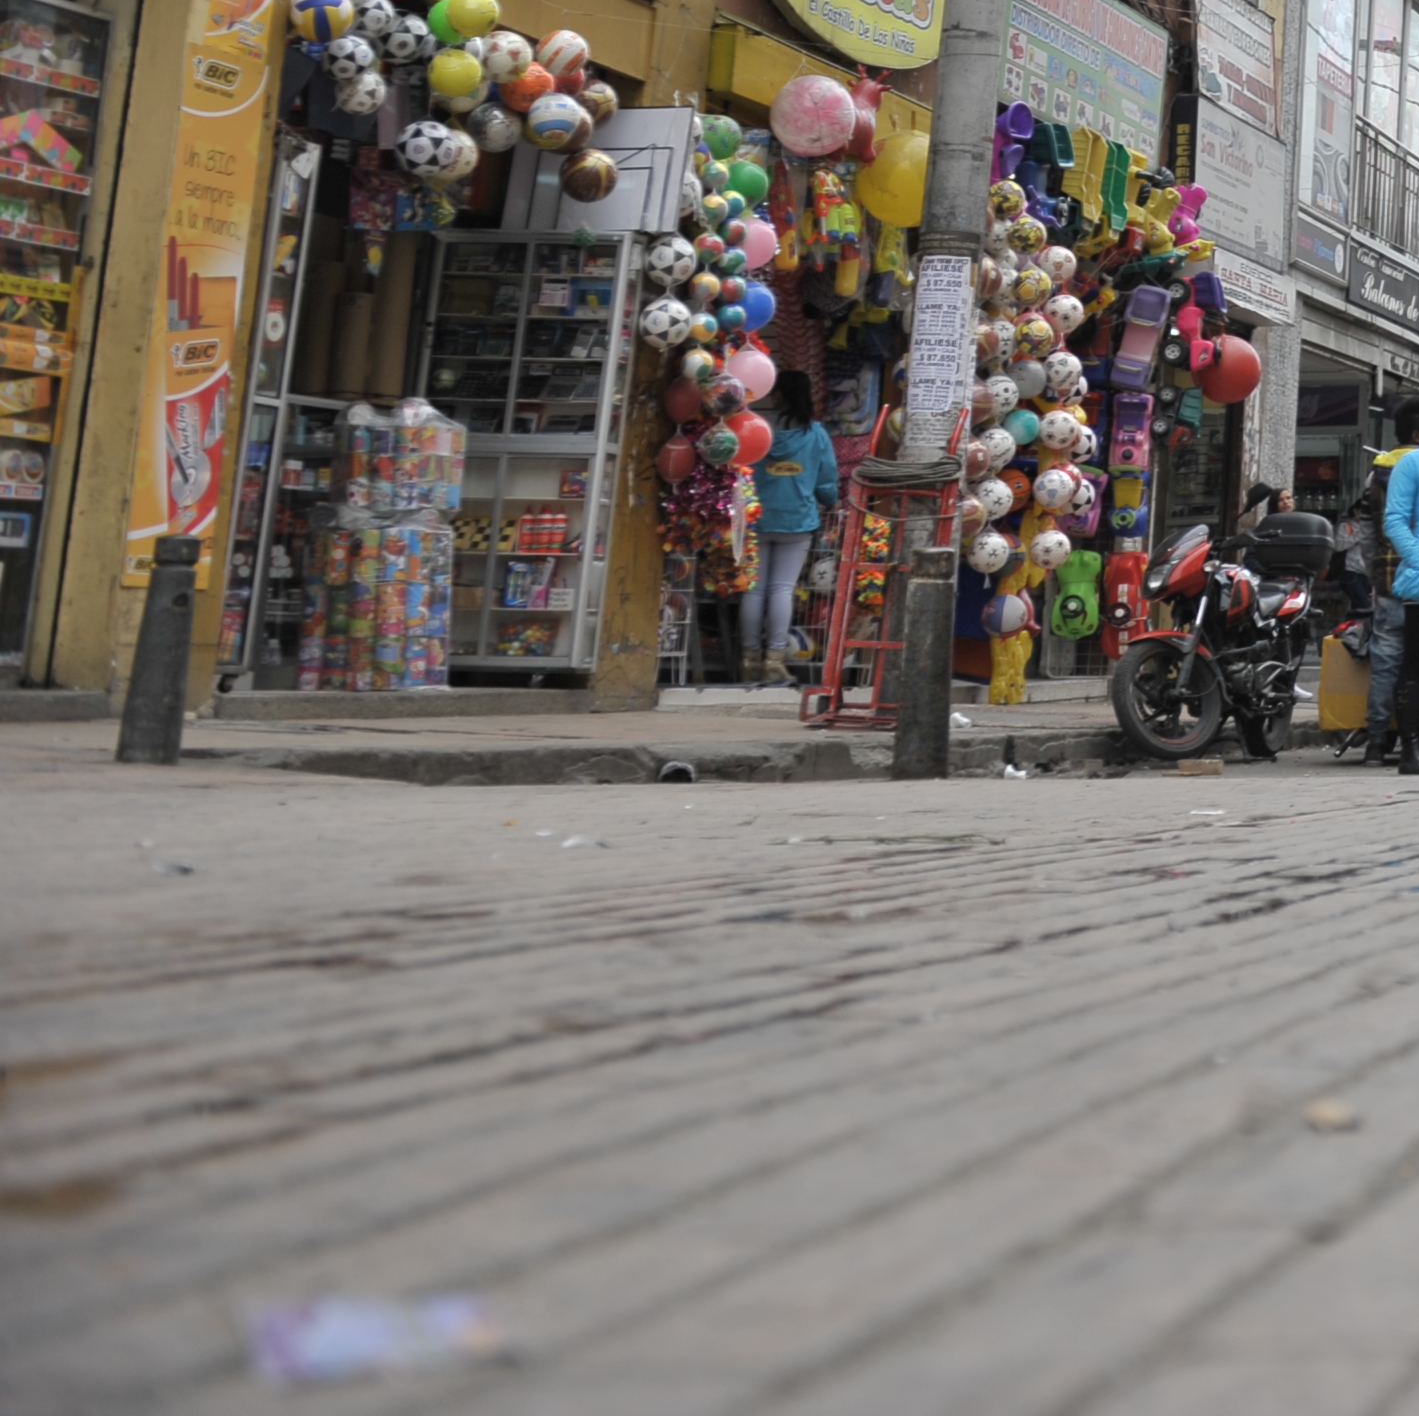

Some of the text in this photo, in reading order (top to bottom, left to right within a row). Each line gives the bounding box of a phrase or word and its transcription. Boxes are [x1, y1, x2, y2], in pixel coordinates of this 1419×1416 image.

[184, 179, 236, 207] siempre
[1361, 272, 1405, 317] Balcones
[1406, 295, 1419, 322] de
